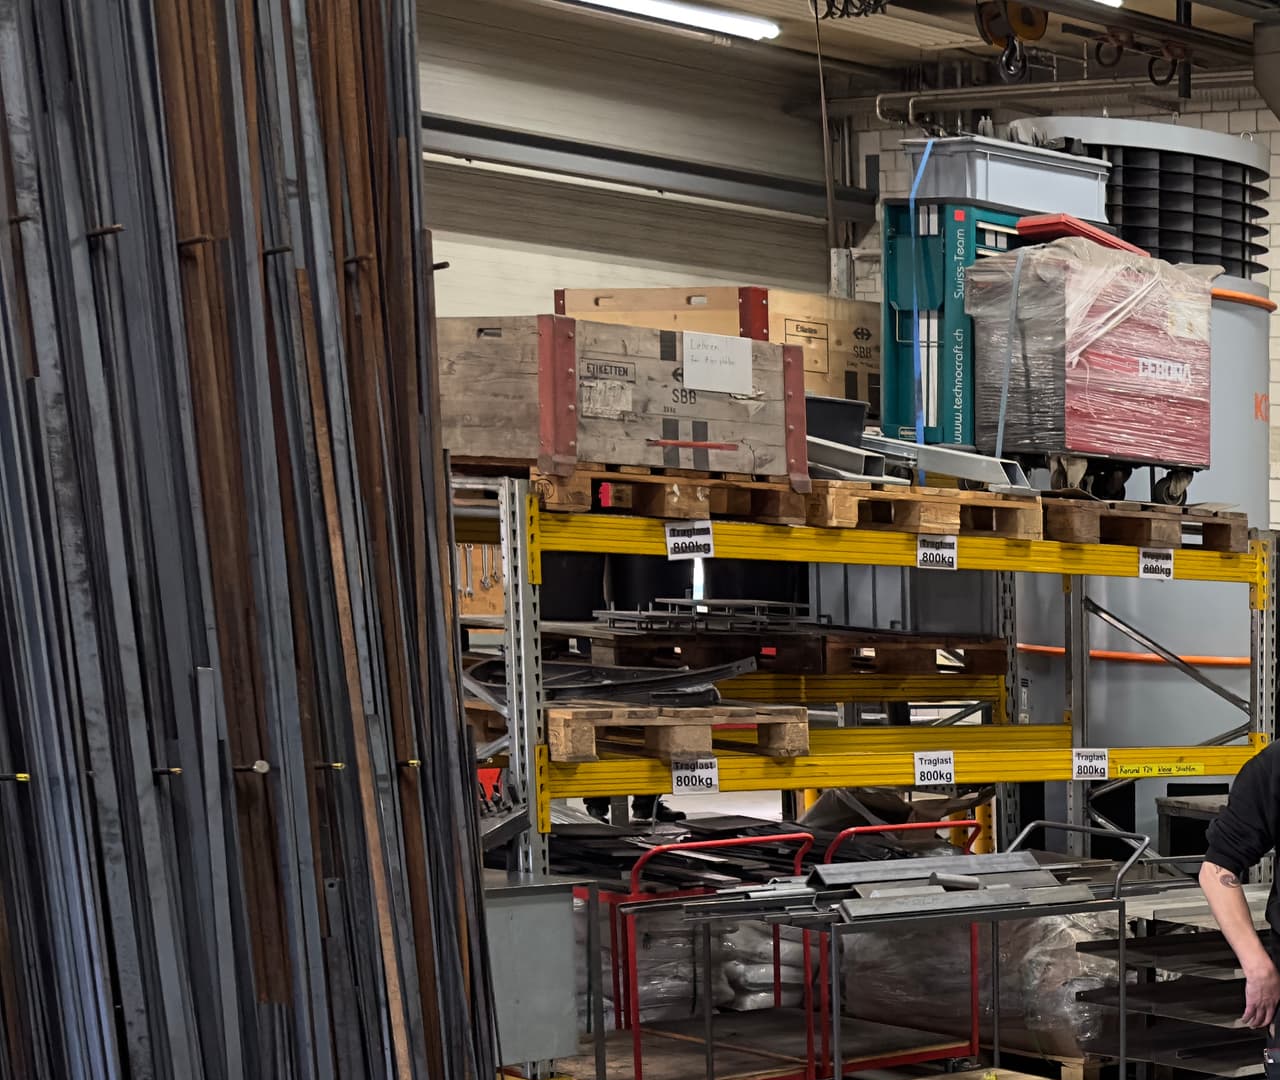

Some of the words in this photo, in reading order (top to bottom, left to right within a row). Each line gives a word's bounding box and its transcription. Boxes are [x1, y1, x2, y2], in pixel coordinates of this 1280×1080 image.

[953, 228, 966, 299] Swiss-Team
[853, 345, 872, 359] SBB
[953, 328, 965, 445] www.technocraft.ch
[671, 388, 697, 404] SBB
[673, 540, 711, 554] 800kg
[922, 552, 955, 568] 800kg
[918, 756, 952, 767] Traglast
[1076, 753, 1106, 762] Traglast
[674, 761, 714, 772] Traglast
[1077, 765, 1106, 777] 800kg
[676, 775, 713, 788] 800kg
[919, 770, 953, 783] 800kg
